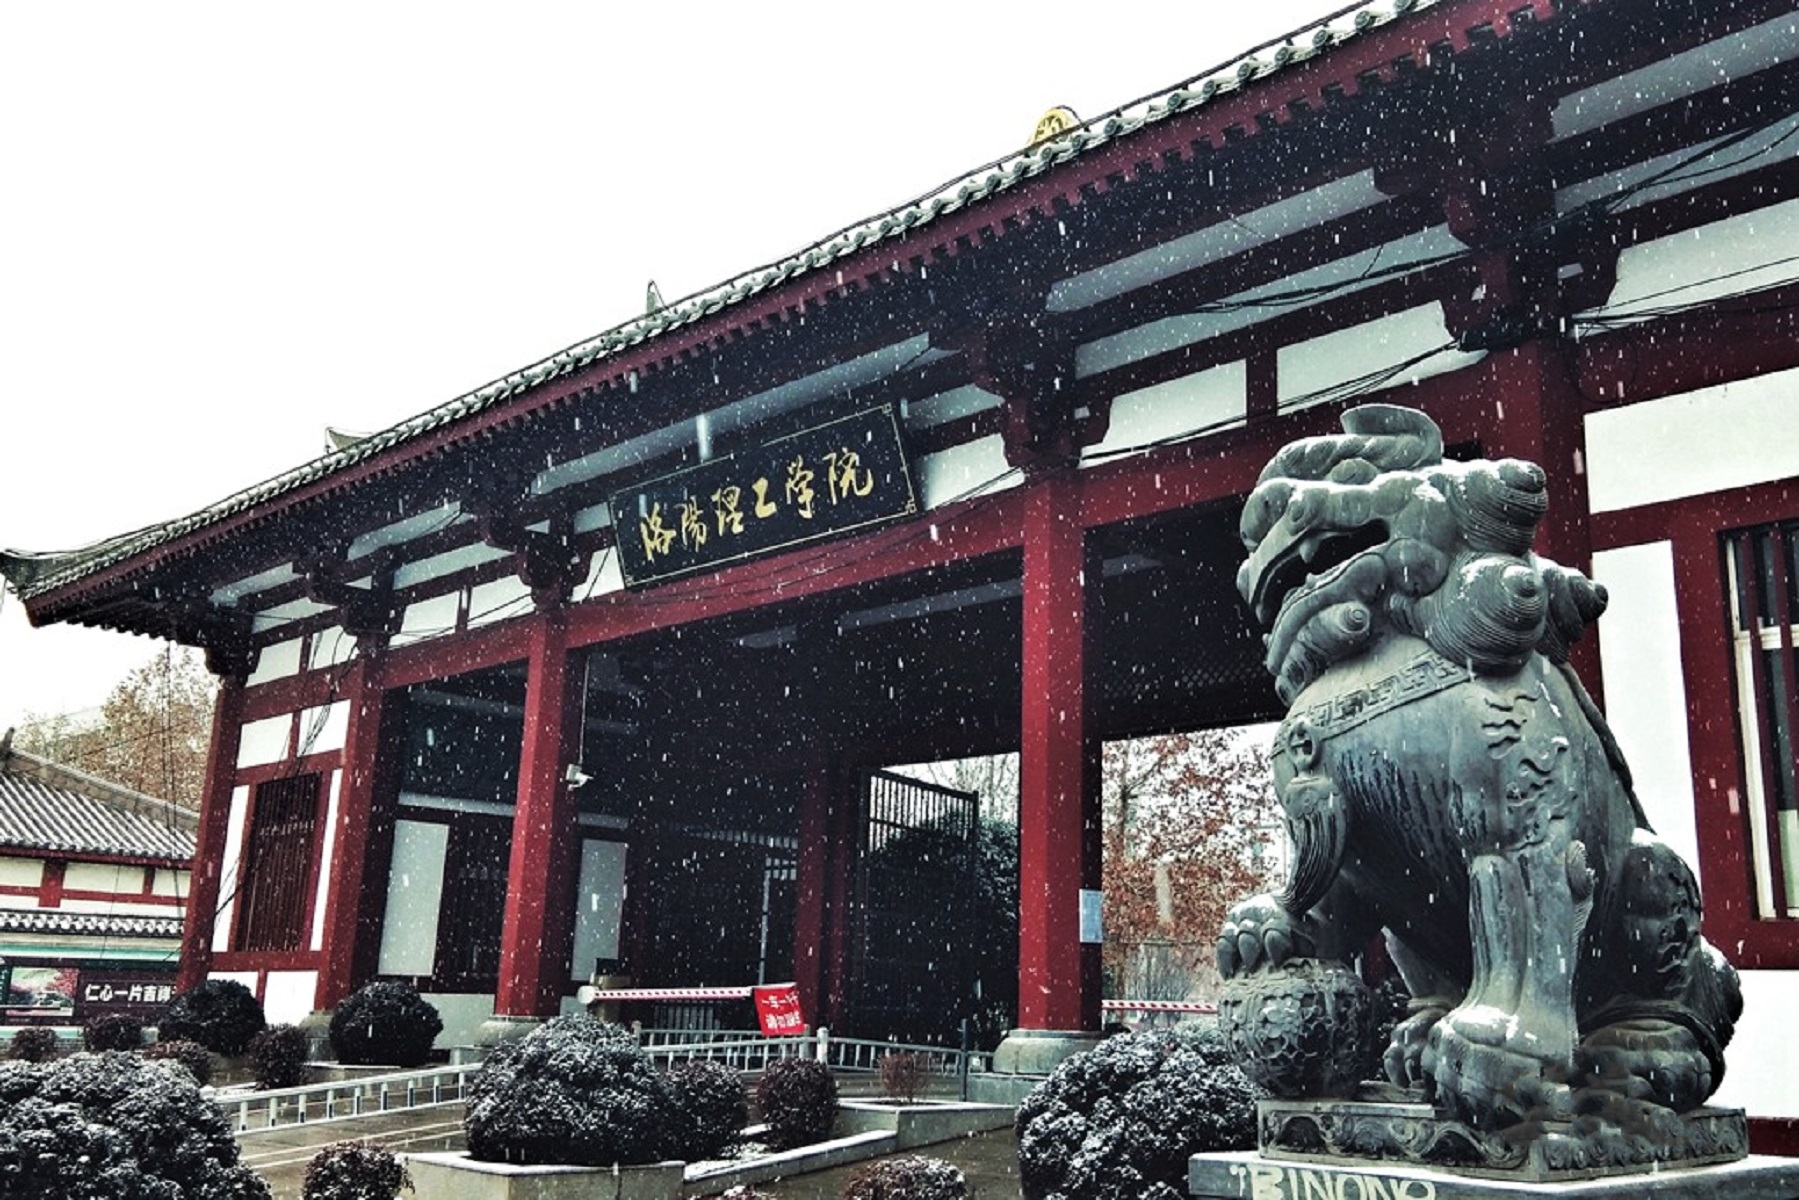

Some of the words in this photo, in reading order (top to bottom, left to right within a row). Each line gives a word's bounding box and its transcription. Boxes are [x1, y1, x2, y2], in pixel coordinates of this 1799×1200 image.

[85, 983, 177, 1003] 仁心一片吉祥
